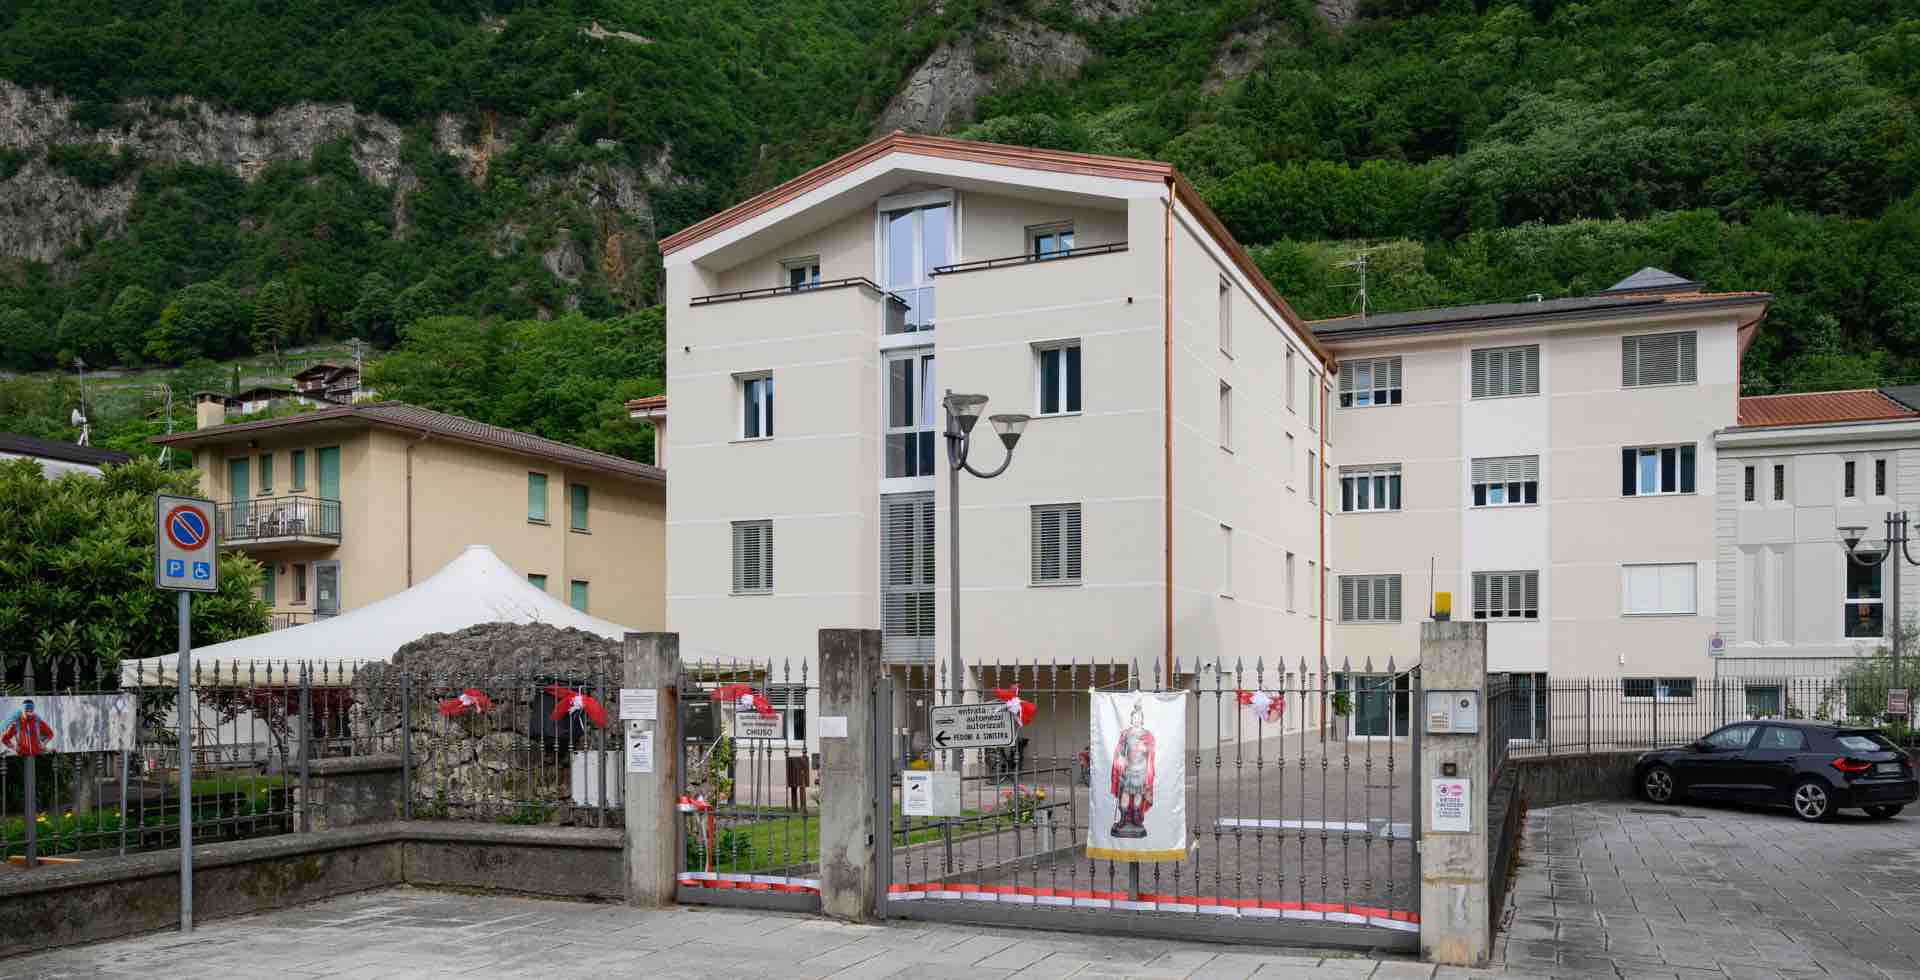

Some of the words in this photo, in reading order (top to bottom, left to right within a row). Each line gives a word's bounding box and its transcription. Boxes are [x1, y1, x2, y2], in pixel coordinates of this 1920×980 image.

[170, 561, 181, 575] P
[958, 706, 986, 714] entrata
[966, 714, 1004, 722] automezzi
[966, 721, 1006, 730] autorizzati
[746, 728, 773, 736] CHIUSO
[983, 732, 1008, 740] SINISTRA
